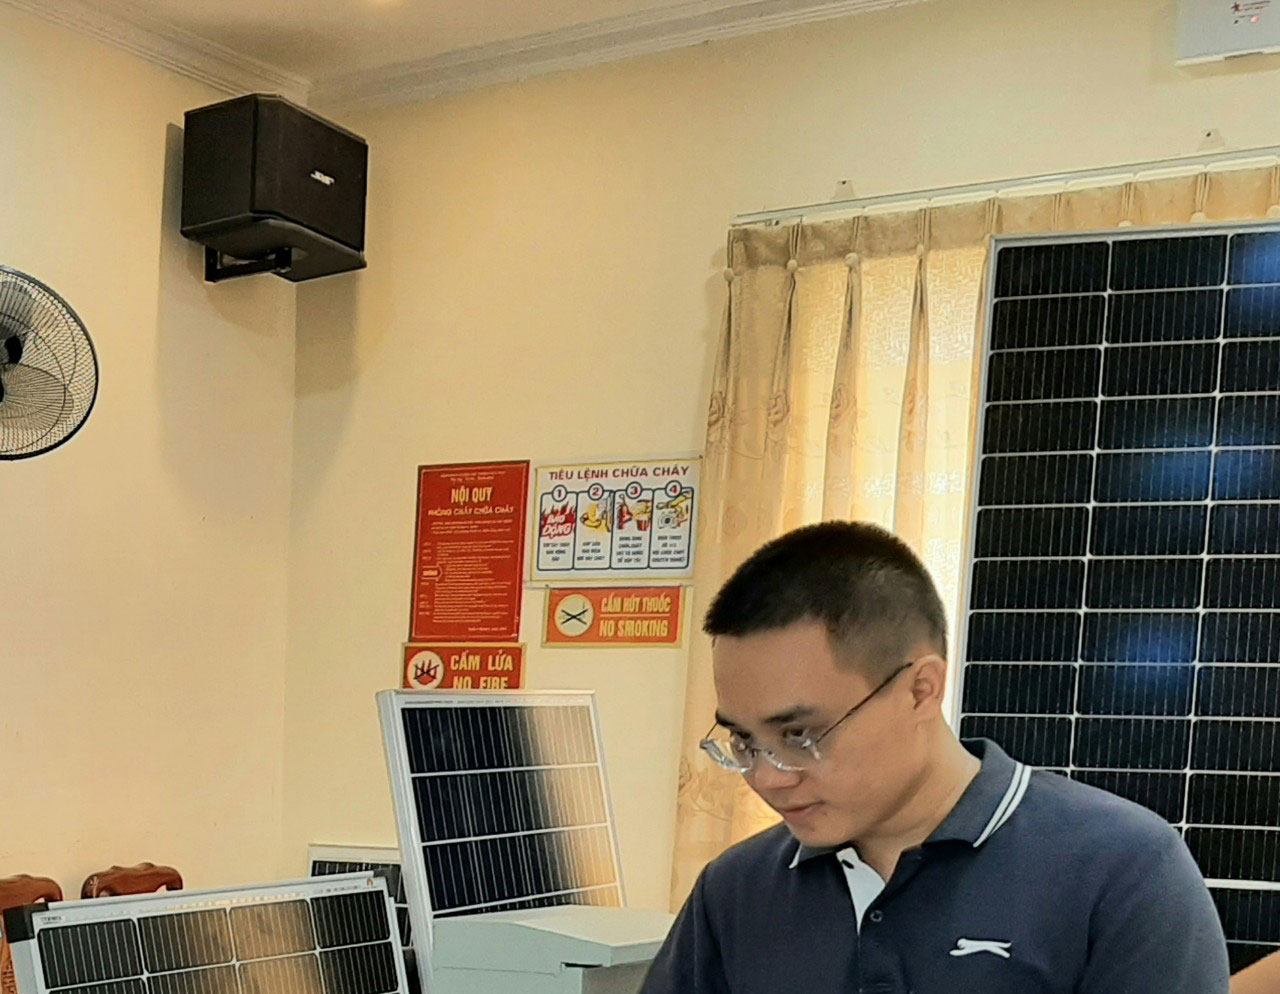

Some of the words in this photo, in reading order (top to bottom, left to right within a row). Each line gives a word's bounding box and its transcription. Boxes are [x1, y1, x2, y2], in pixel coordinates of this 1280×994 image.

[591, 487, 600, 496] 2
[630, 486, 639, 495] 3
[599, 620, 615, 637] NO
[617, 619, 669, 637] SMOKING
[452, 676, 472, 689] NO
[480, 676, 508, 689] FIRE
